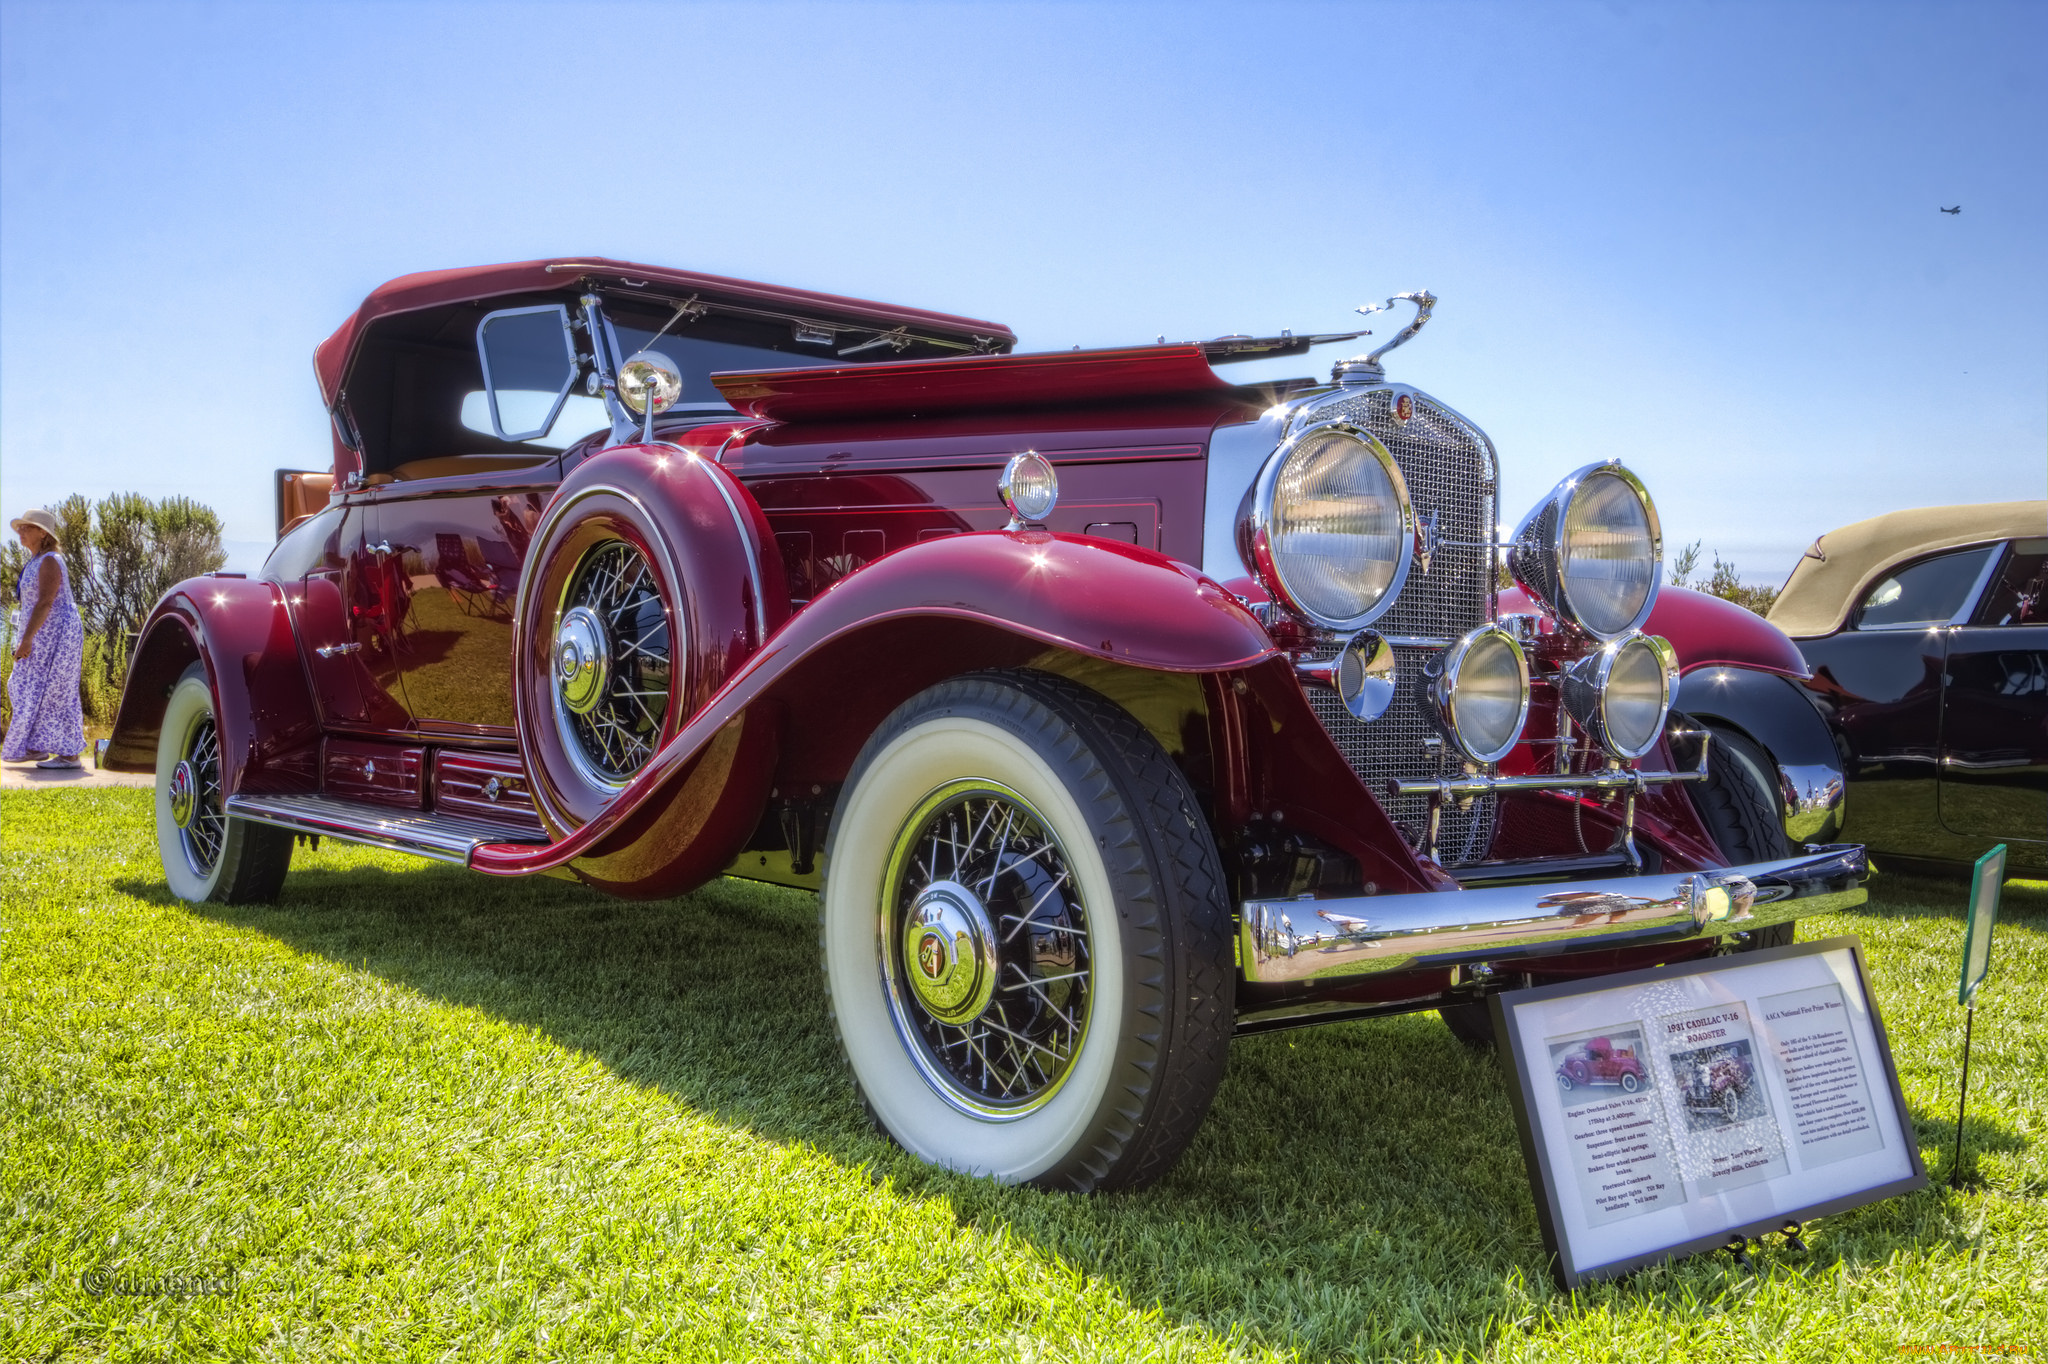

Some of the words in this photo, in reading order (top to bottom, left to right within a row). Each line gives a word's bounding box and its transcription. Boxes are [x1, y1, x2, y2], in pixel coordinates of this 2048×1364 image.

[1780, 1008, 1801, 1017] National
[1667, 1023, 1685, 1033] 1931
[1686, 1016, 1721, 1029] CADILLAC
[1722, 1012, 1739, 1022] V-16
[1687, 1028, 1727, 1043] ROADSTER
[1586, 1105, 1608, 1113] Overhead
[1609, 1125, 1623, 1133] speed
[1586, 1140, 1613, 1149] Suspension:
[1616, 1158, 1630, 1166] wheel
[1631, 1152, 1656, 1163] mechanical
[1602, 1181, 1626, 1191] Fleetwood
[1627, 1175, 1651, 1184] Coachwork
[1605, 1202, 1629, 1212] headlamps
